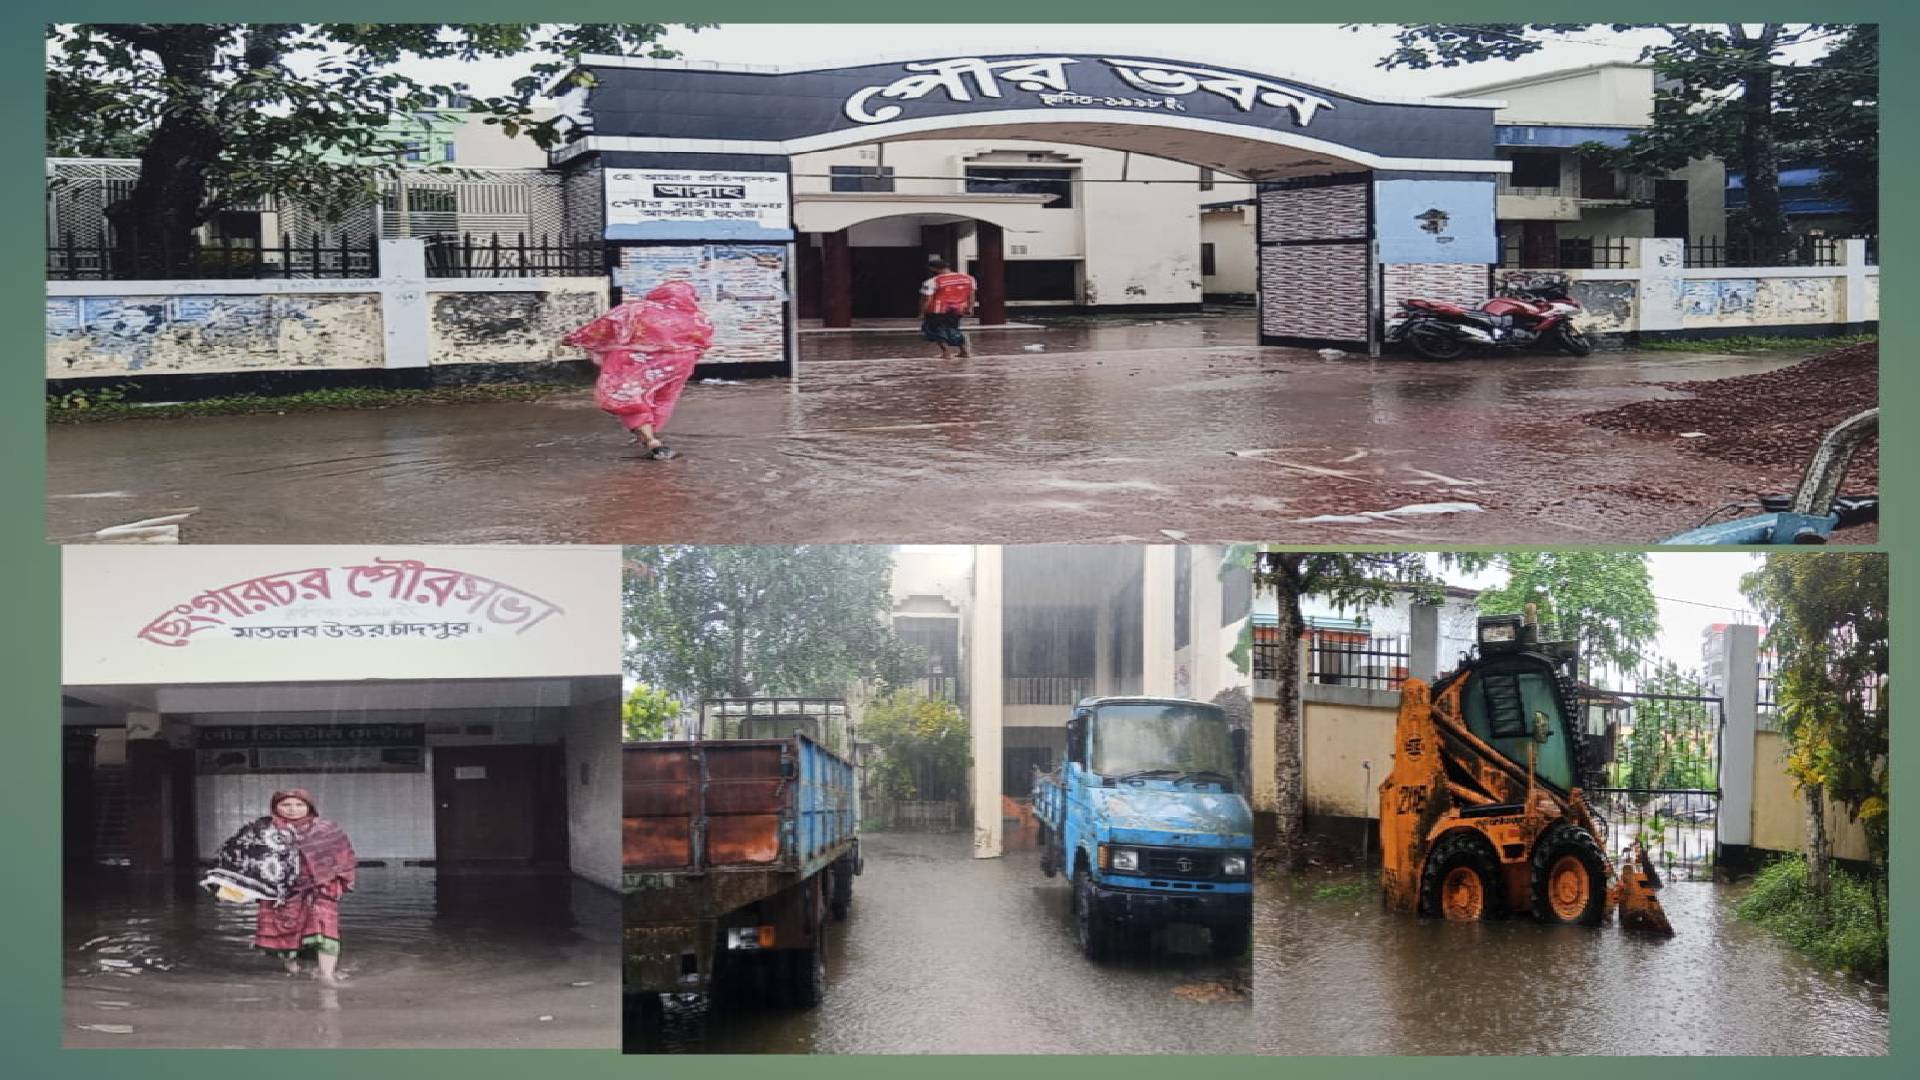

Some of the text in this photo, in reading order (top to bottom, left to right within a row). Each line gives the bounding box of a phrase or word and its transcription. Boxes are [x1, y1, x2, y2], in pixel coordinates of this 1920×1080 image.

[846, 57, 1337, 127] পৌর ভবন
[137, 557, 566, 647] ছেংগারচর পৌরসভা
[230, 623, 319, 639] মতলব
